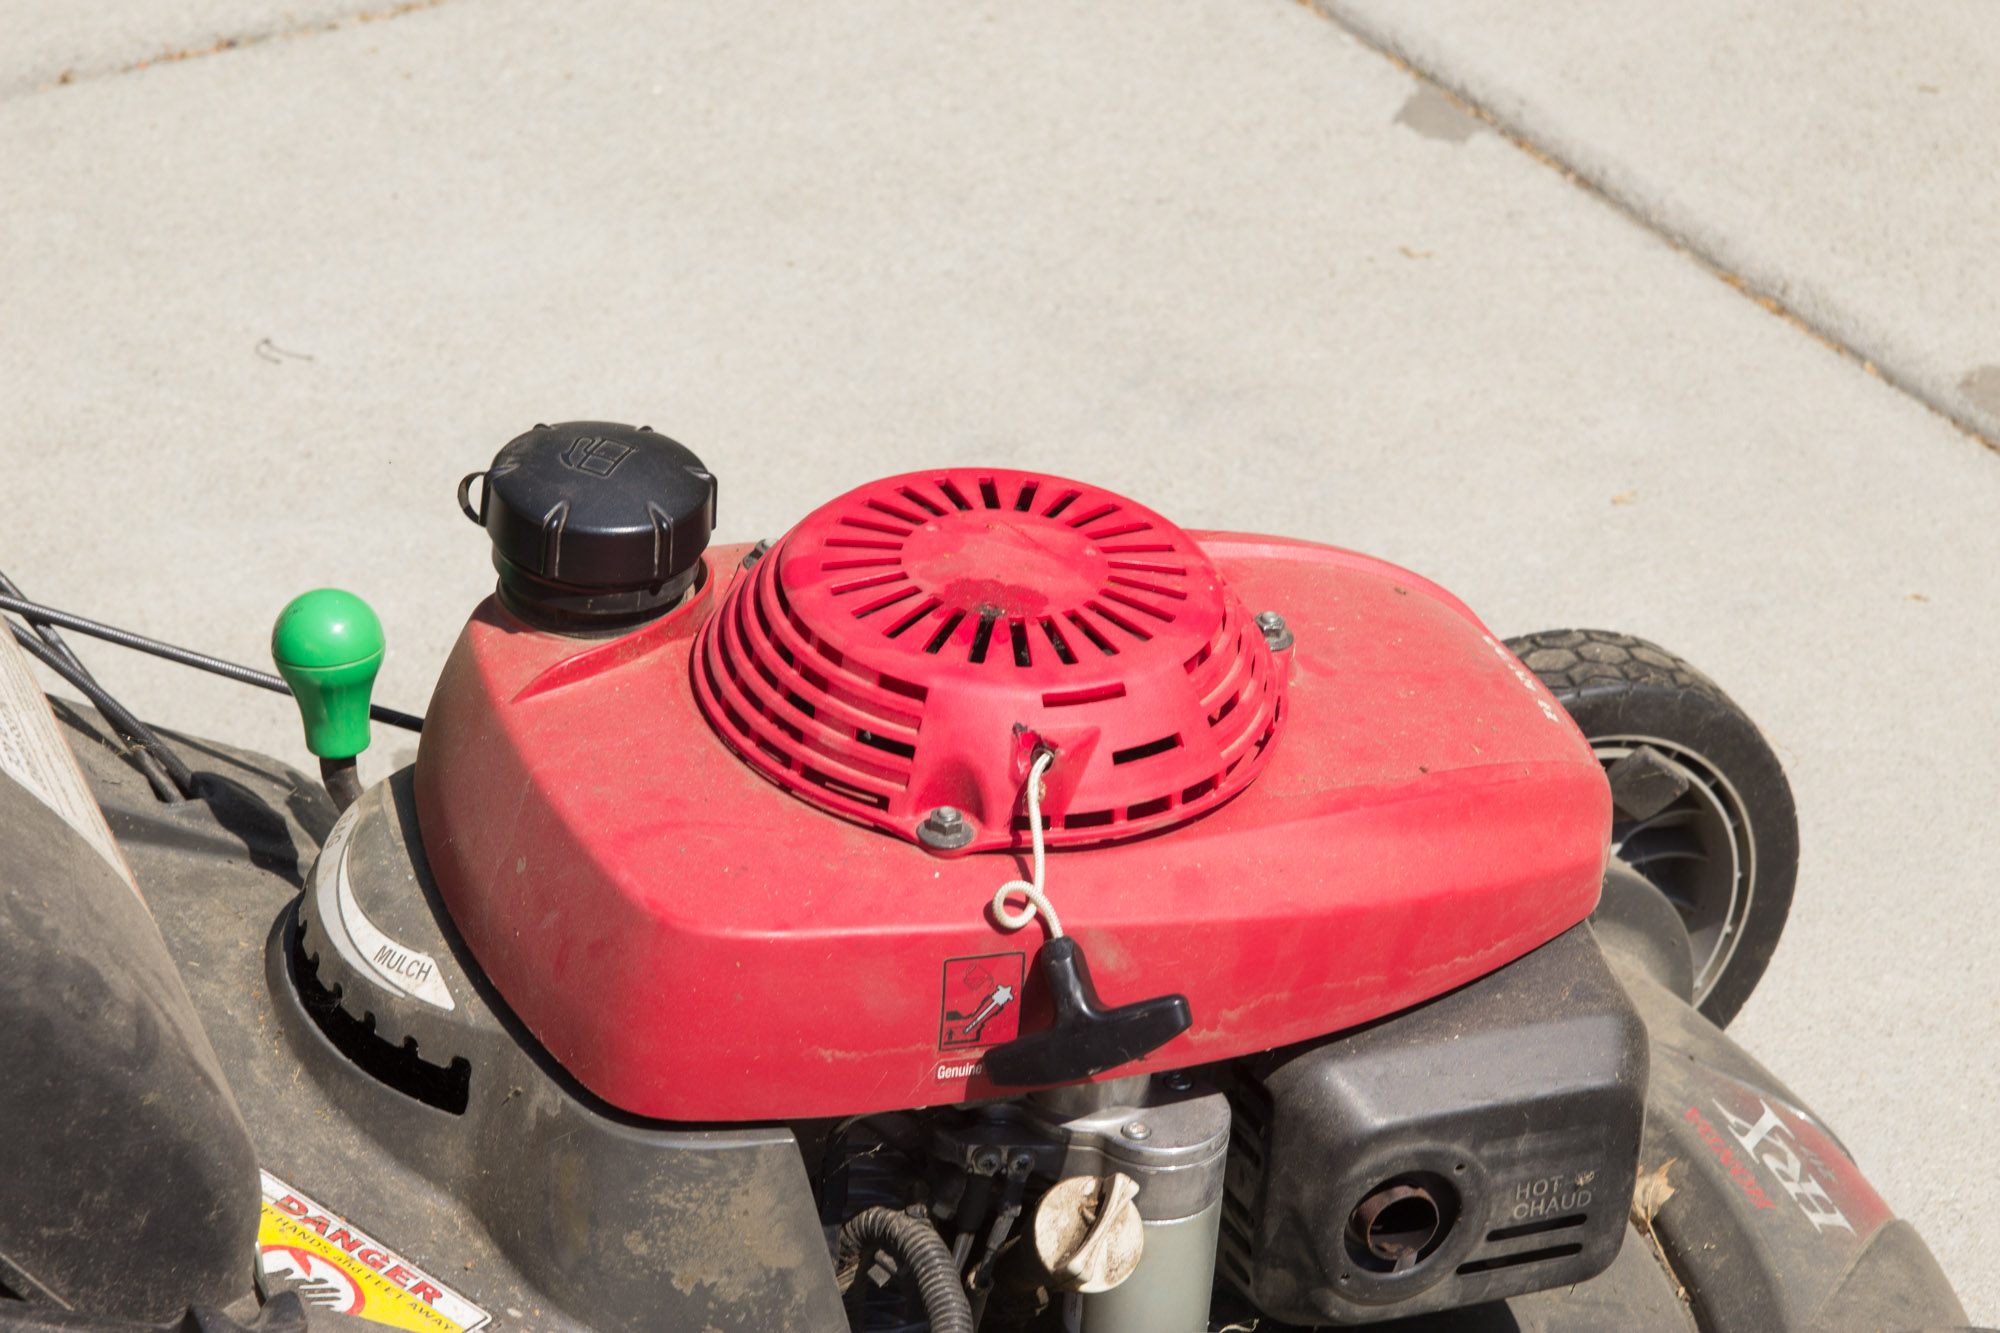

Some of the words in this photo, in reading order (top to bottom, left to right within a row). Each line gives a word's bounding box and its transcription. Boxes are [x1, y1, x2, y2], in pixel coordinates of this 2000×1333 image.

[373, 945, 433, 982] MULCH
[937, 1062, 983, 1080] Genuine
[1685, 1105, 1776, 1209] HONDA
[1513, 1190, 1592, 1220] CHAUD
[1516, 1174, 1564, 1200] HOT
[274, 1195, 443, 1305] DANGER
[276, 1216, 330, 1254] HANDS
[332, 1254, 363, 1274] and
[407, 1302, 456, 1332] AWAY
